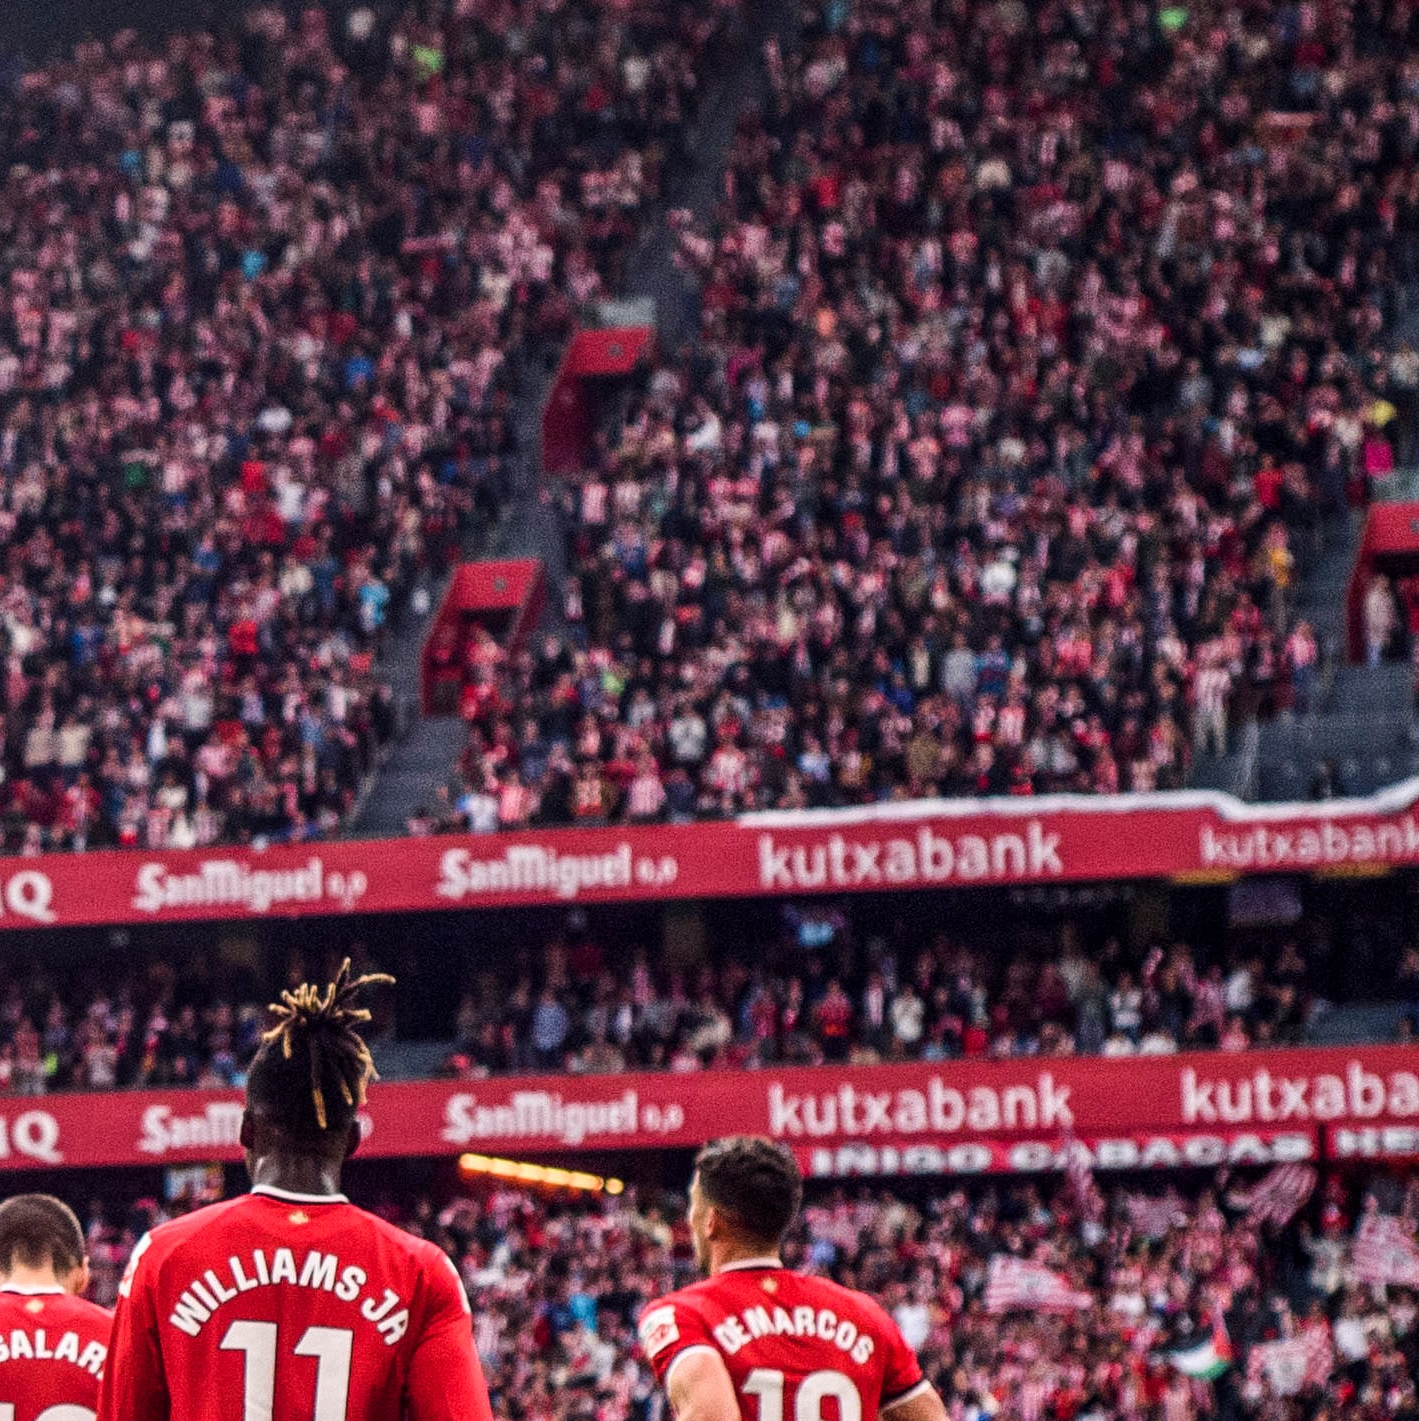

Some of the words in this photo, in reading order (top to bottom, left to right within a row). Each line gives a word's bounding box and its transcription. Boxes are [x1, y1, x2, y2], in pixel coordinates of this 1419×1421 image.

[759, 821, 1063, 888] kutxabank
[768, 1070, 1073, 1138] kutxabank
[169, 1247, 367, 1338] WILLIAMS
